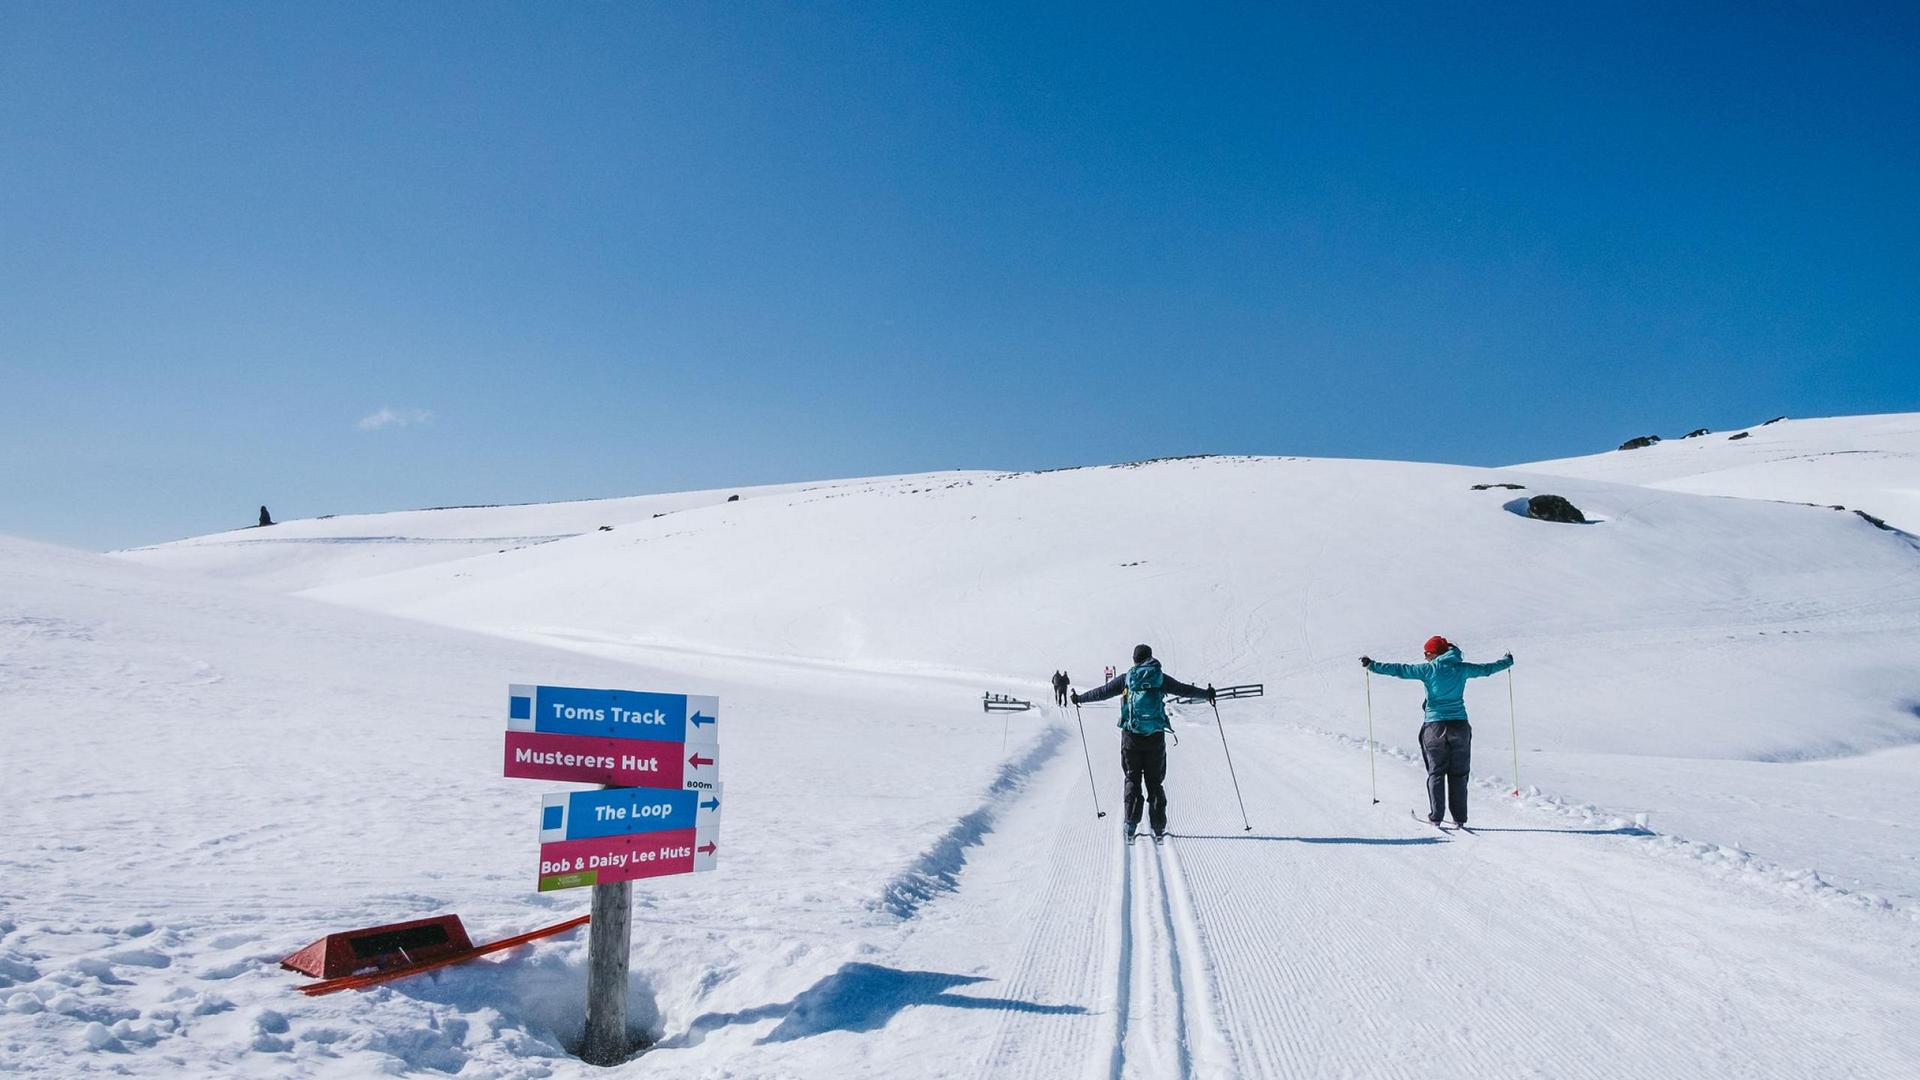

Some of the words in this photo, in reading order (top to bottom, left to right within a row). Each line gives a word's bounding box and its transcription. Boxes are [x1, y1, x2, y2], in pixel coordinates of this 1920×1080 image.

[553, 703, 605, 721] Toms
[611, 707, 666, 725] Track
[515, 748, 615, 769] Musterers
[621, 755, 658, 772] Hut
[686, 780, 712, 790] 800m
[595, 806, 626, 821] The
[631, 803, 672, 818] Loop
[541, 860, 571, 874] Bob
[575, 858, 585, 870] &
[589, 853, 627, 869] Daisy
[632, 850, 656, 863] Lee
[660, 846, 691, 860] Huts
